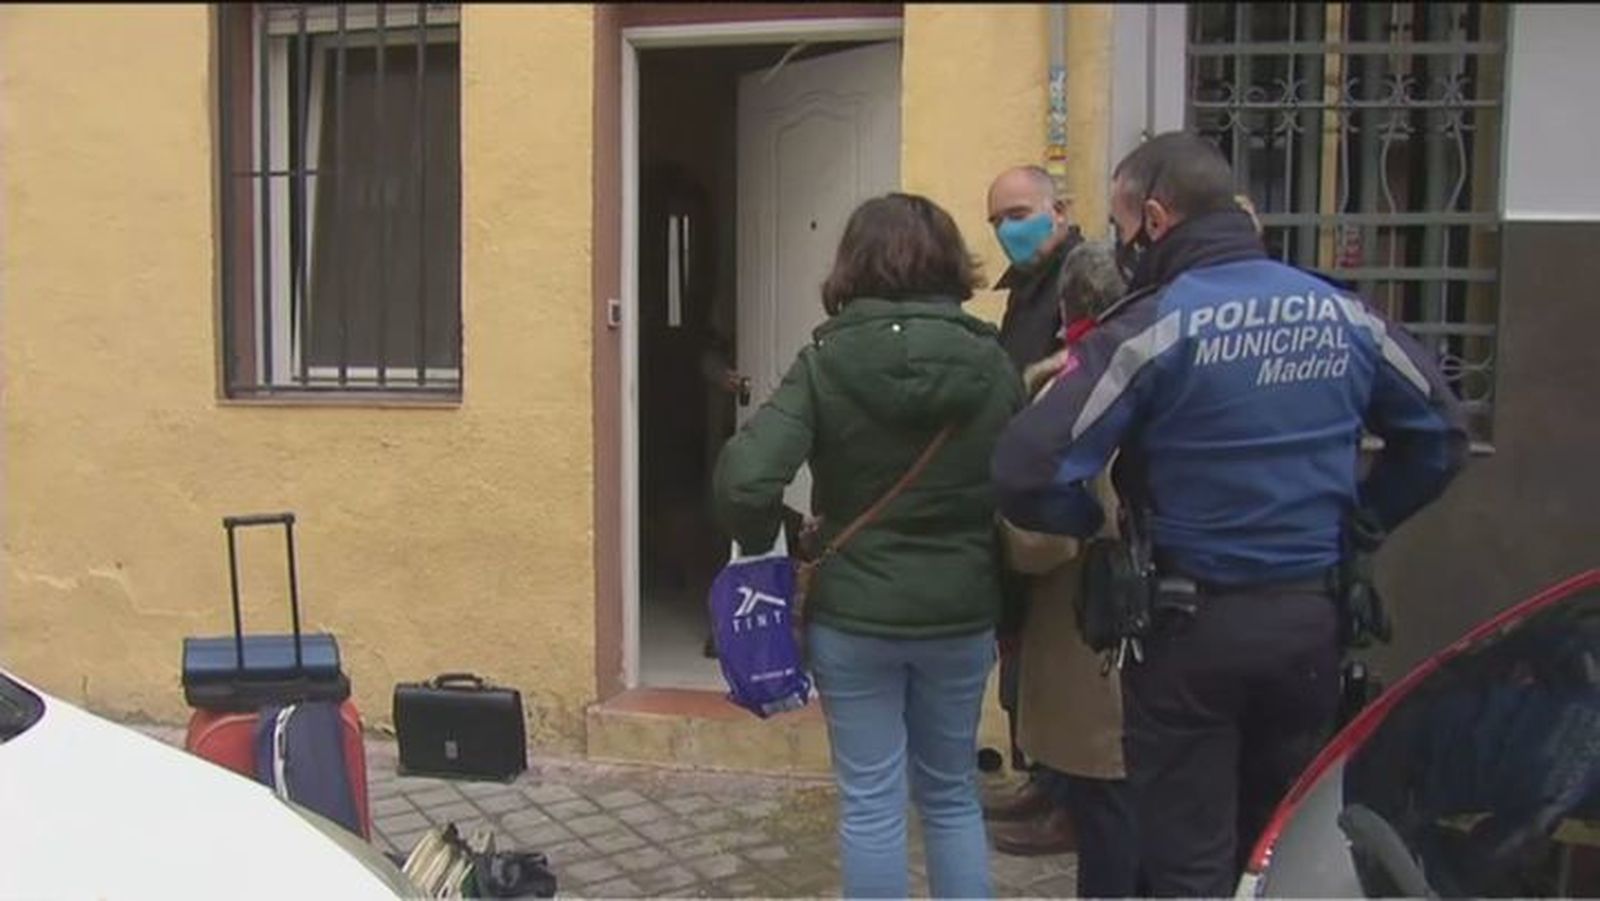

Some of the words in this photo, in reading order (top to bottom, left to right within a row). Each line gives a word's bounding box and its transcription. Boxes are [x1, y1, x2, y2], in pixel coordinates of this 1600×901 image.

[1189, 292, 1337, 335] POLICÍA
[1195, 327, 1349, 365] MUNICIPAL
[1257, 353, 1350, 384] Madrid
